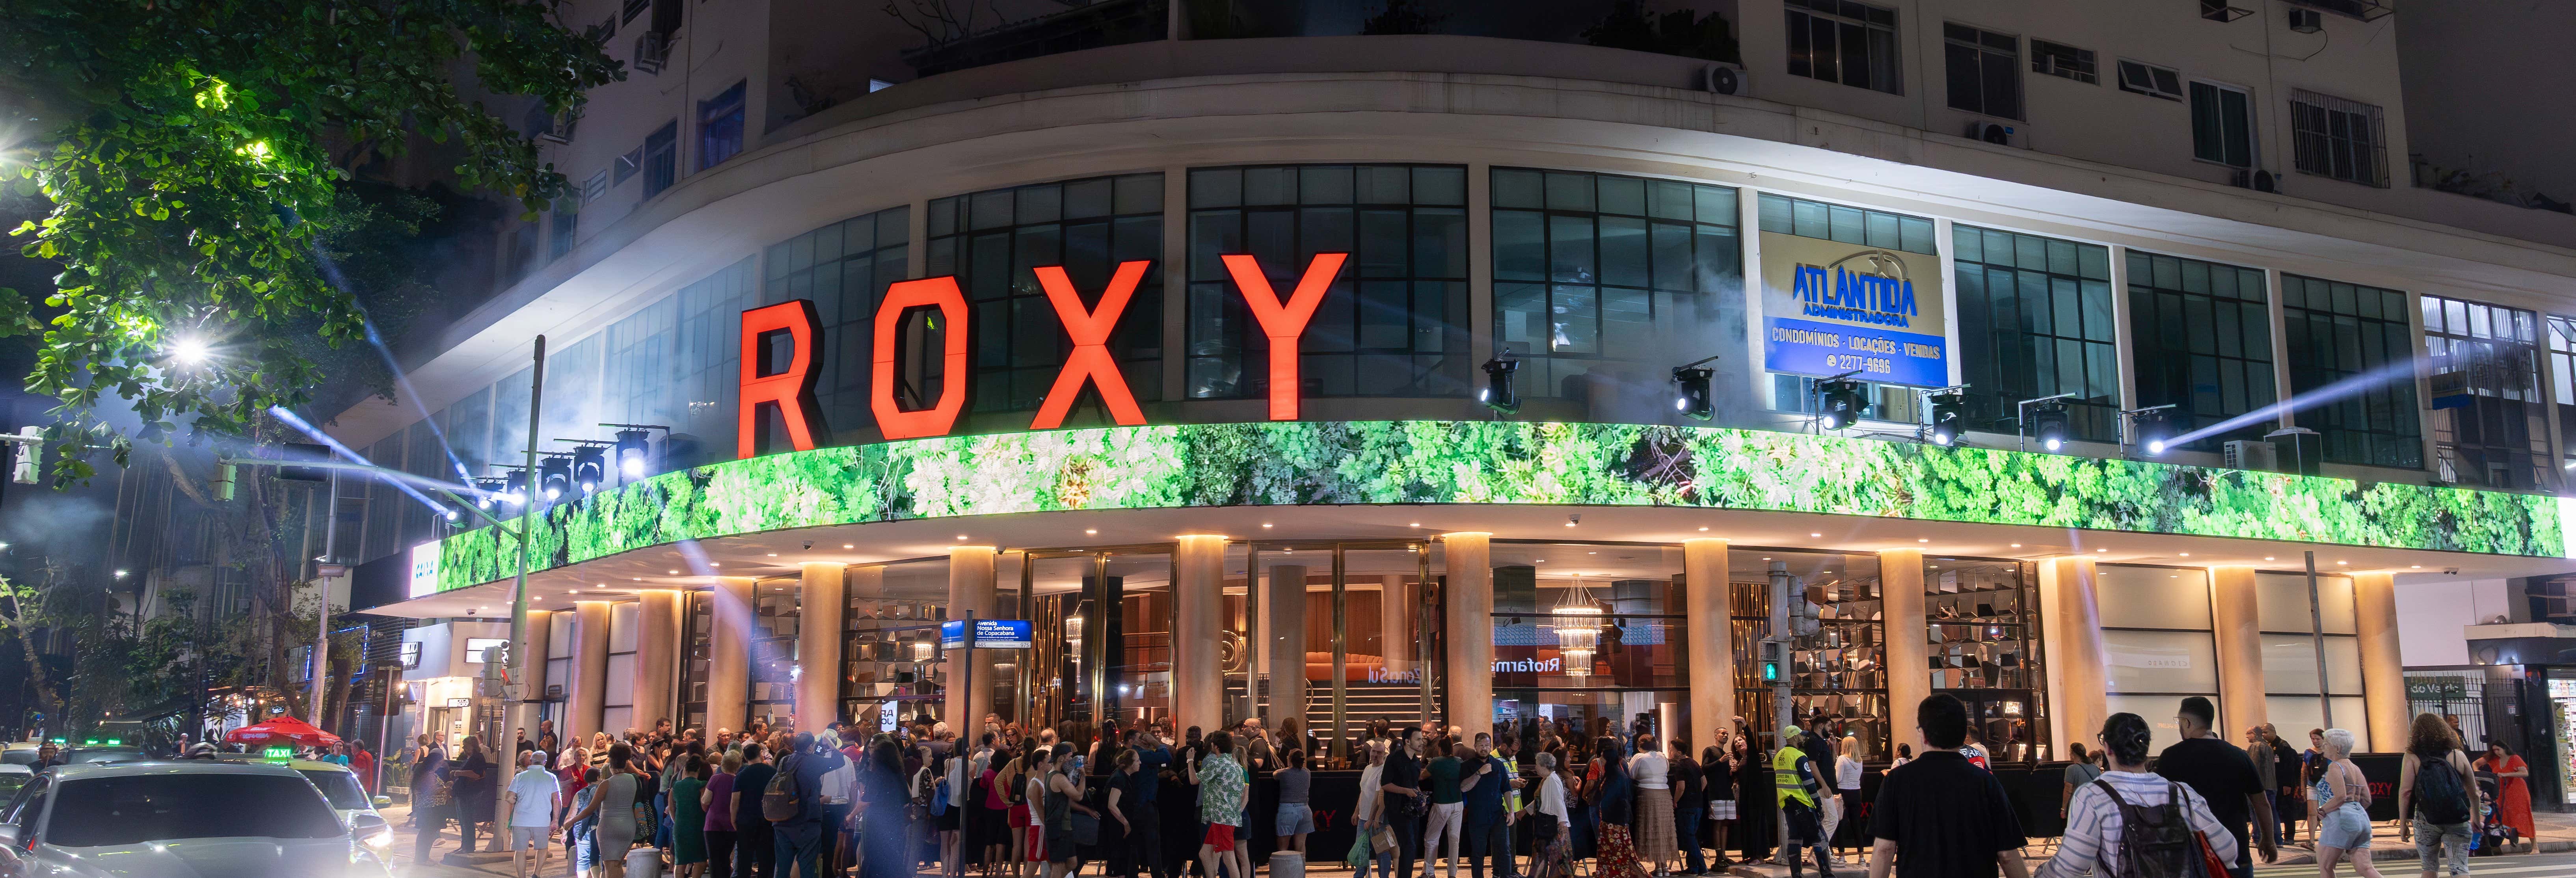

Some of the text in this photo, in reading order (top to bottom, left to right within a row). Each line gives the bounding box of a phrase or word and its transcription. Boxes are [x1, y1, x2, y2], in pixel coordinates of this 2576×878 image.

[1793, 264, 1917, 316] ATLÂNTIDA
[1803, 303, 1909, 328] ADMINISTRADORA
[1772, 327, 1941, 359] CONDOMÍNIOS LOCAÇÕES VENDAS
[738, 253, 1349, 460] ROXY
[1840, 355, 1891, 374] 2277-9696
[2427, 684, 2459, 693] Vede
[268, 749, 290, 757] TAXI
[2368, 782, 2392, 795] OXY
